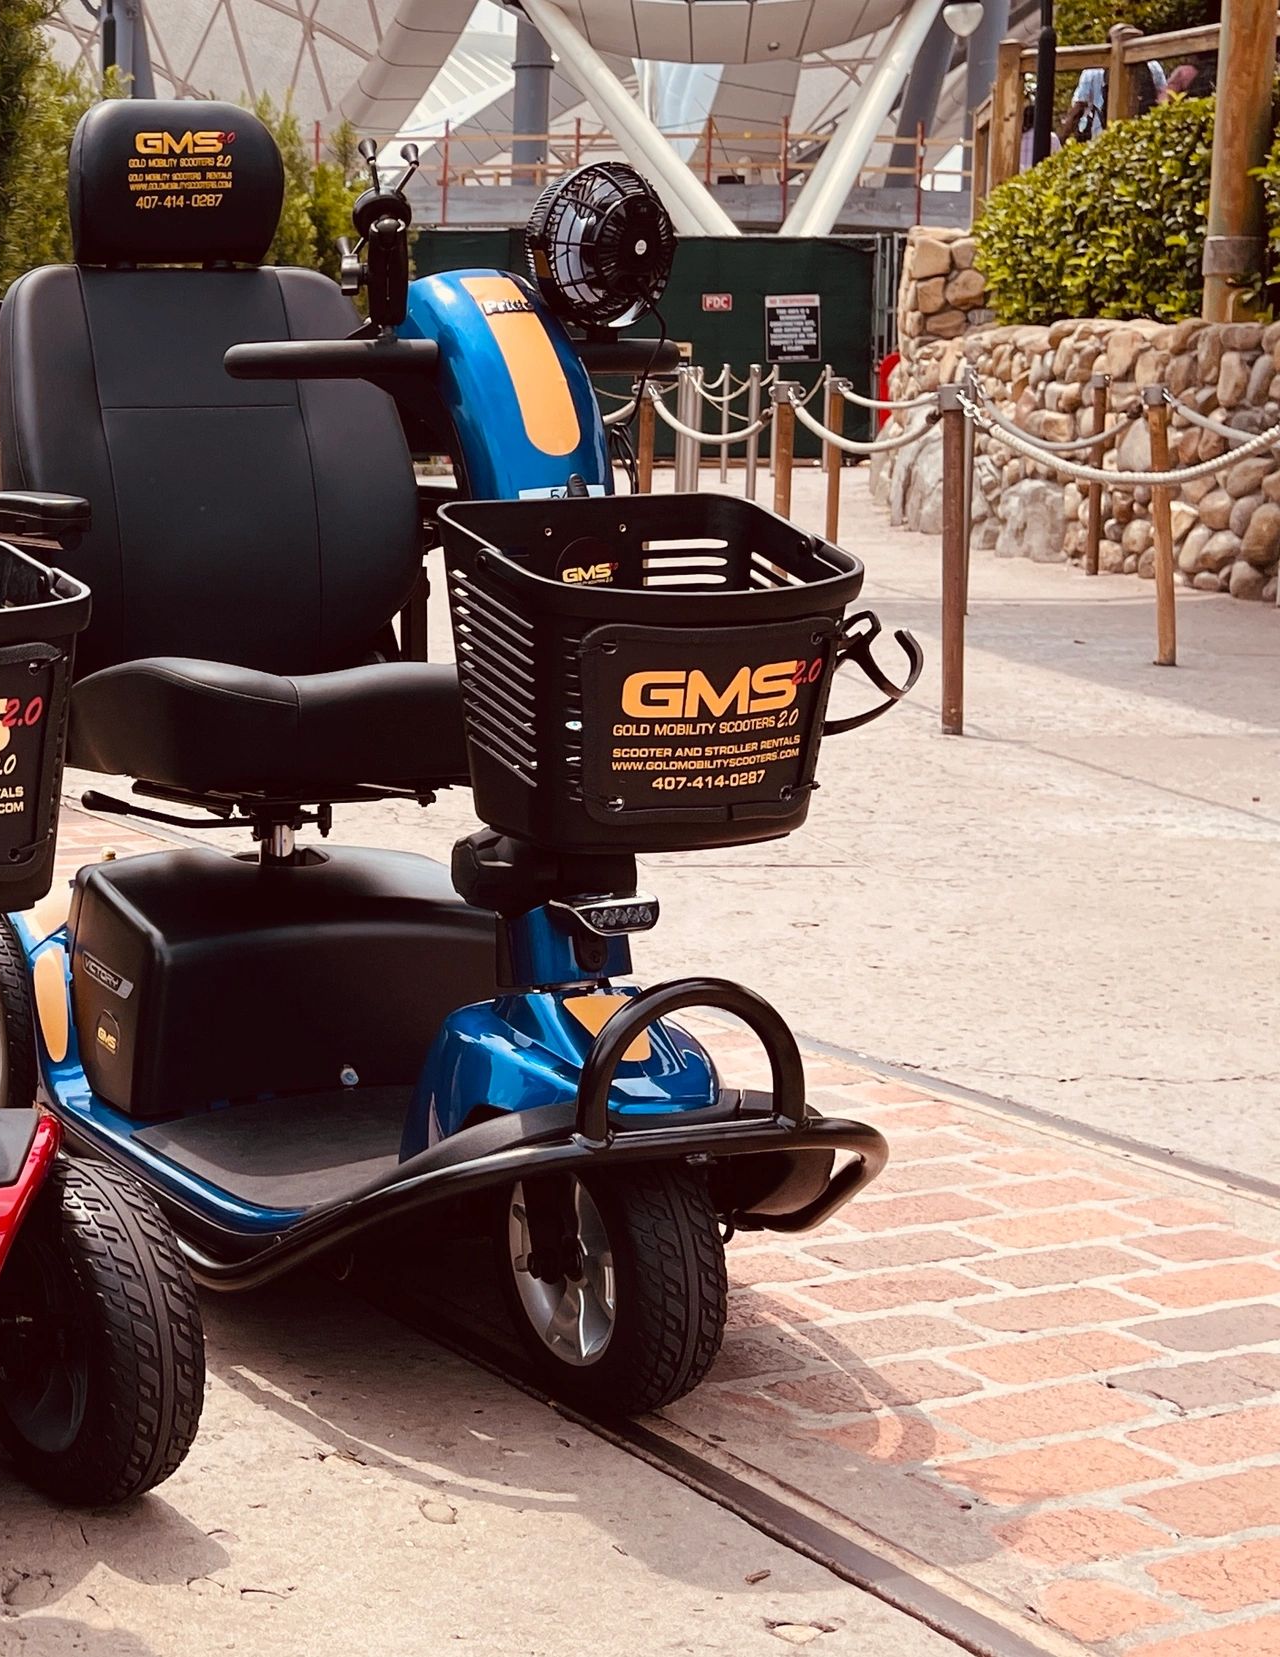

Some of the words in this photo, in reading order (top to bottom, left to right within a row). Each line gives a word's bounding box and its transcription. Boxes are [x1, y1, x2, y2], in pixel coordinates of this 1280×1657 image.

[135, 130, 223, 154] GMS
[128, 158, 146, 168] GOLD
[216, 155, 232, 167] 2.0
[135, 194, 223, 209] 407-414-0287
[562, 563, 611, 583] GMS
[621, 660, 798, 718] GMS
[791, 658, 822, 685] 2.0
[2, 696, 43, 727] 2.0
[612, 724, 650, 737] GOLD
[654, 722, 716, 736] MOBILITY
[719, 716, 776, 734] SCOOTERS
[777, 708, 799, 729] 2.0
[612, 747, 672, 758] SCOOTER
[674, 747, 702, 757] AND
[704, 741, 758, 756] STROLLER
[760, 734, 801, 750] RENTALS
[612, 748, 799, 771] WWW.GOLDMOBILITYSCOOTERS.COM
[652, 769, 766, 791] 407-414-0287
[85, 956, 119, 988] VICTORY
